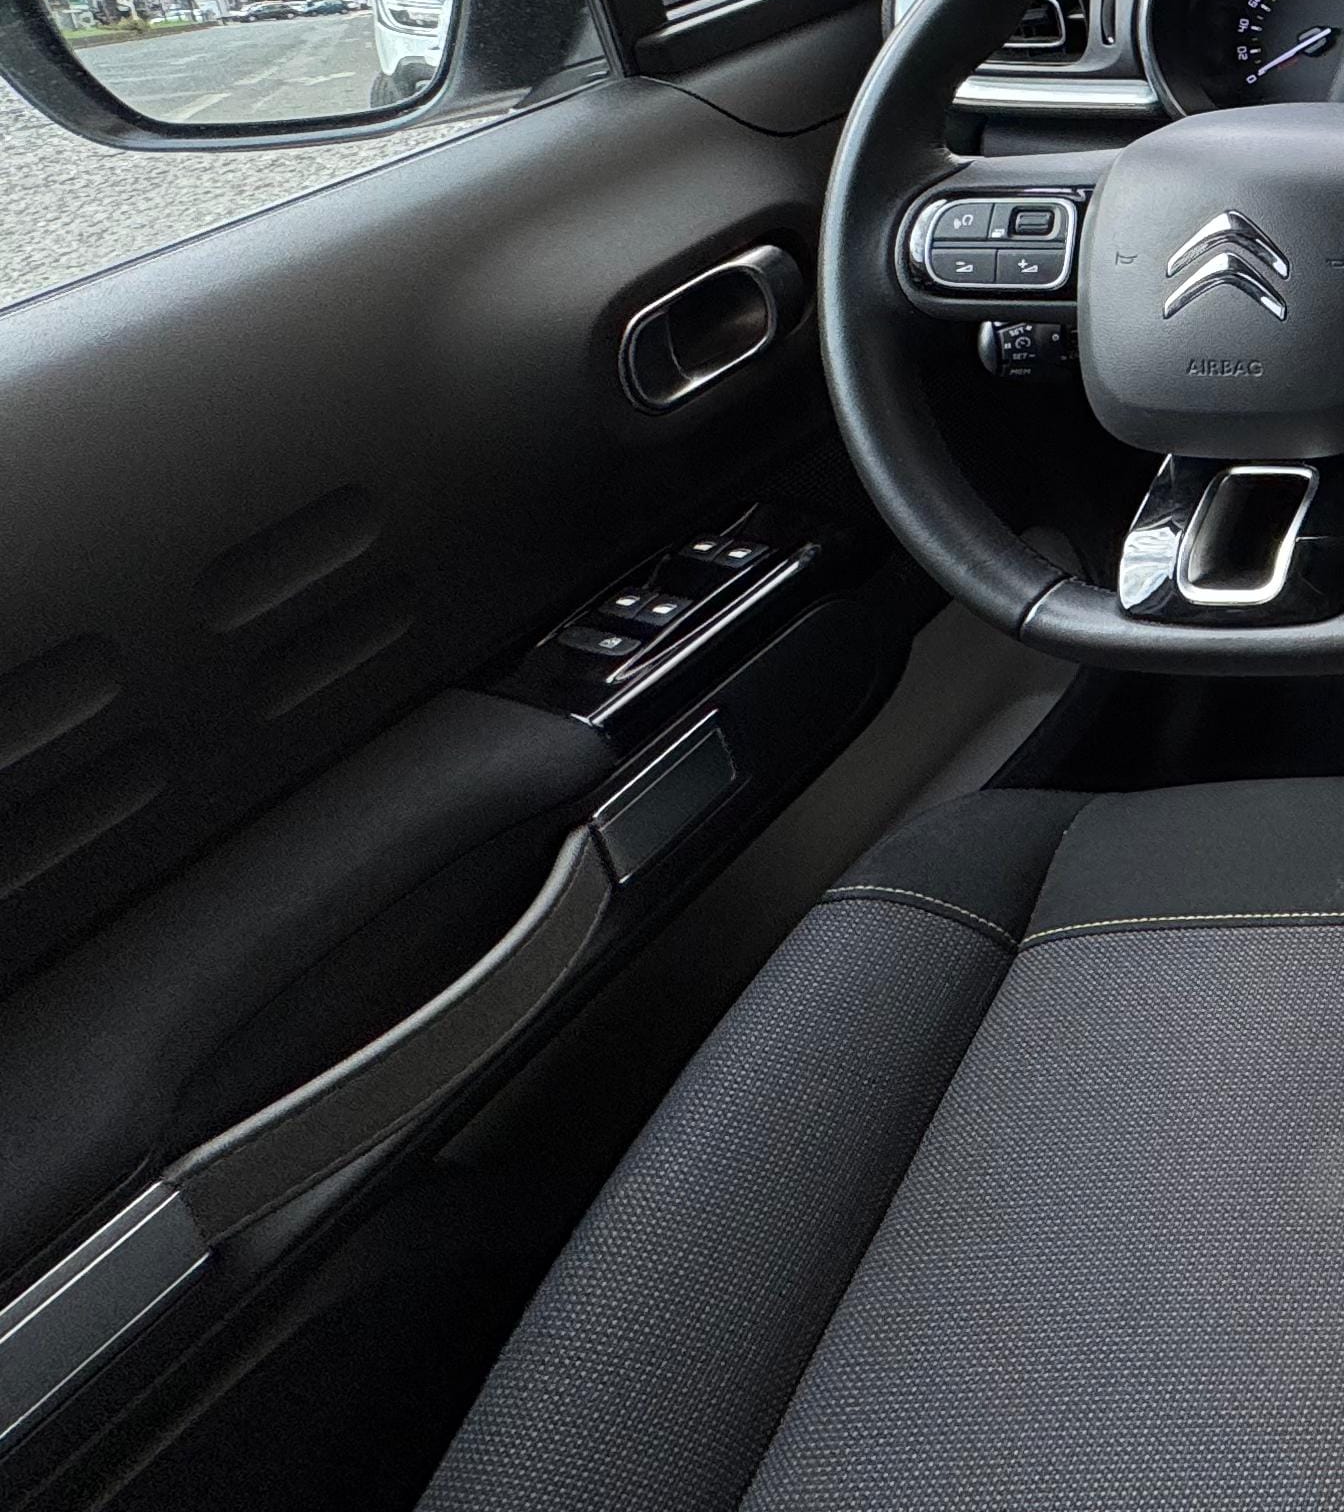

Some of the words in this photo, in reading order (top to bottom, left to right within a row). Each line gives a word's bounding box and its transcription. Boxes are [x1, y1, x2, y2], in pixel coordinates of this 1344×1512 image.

[1237, 19, 1250, 33] 40
[1236, 46, 1249, 61] 20
[1246, 74, 1258, 84] 0
[1186, 358, 1264, 377] AIRBAG
